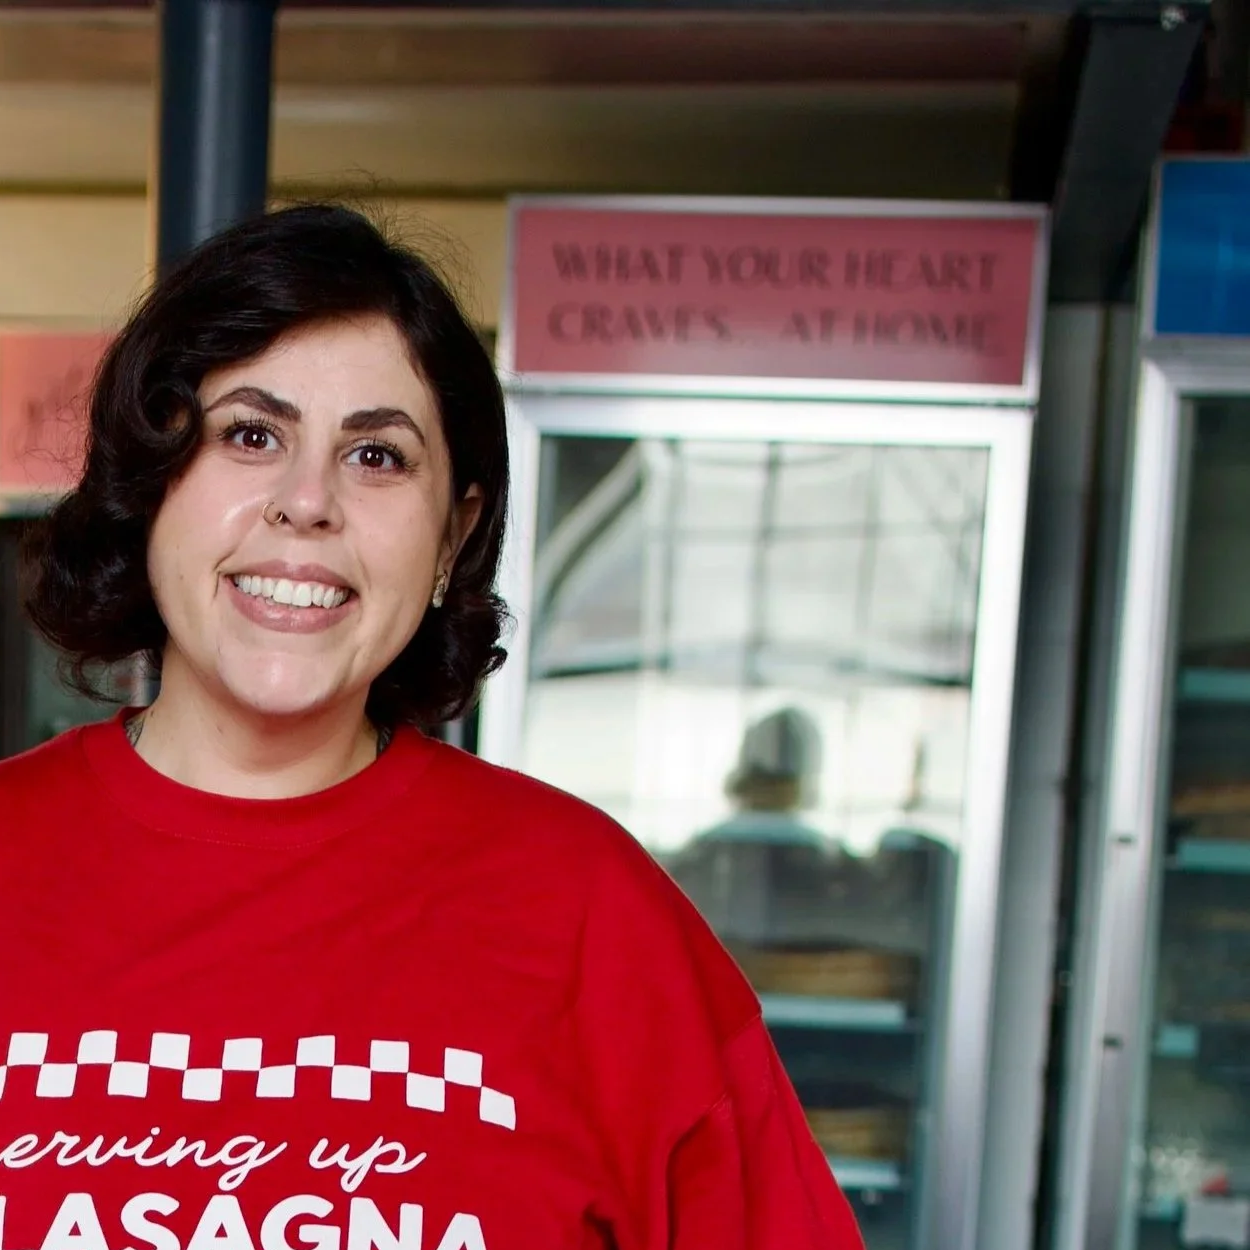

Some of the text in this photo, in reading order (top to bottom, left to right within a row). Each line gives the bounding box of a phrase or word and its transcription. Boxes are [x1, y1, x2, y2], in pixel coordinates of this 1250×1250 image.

[551, 241, 999, 295] WHAT YOUR HEART
[779, 306, 842, 349] AT
[308, 1135, 427, 1193] up
